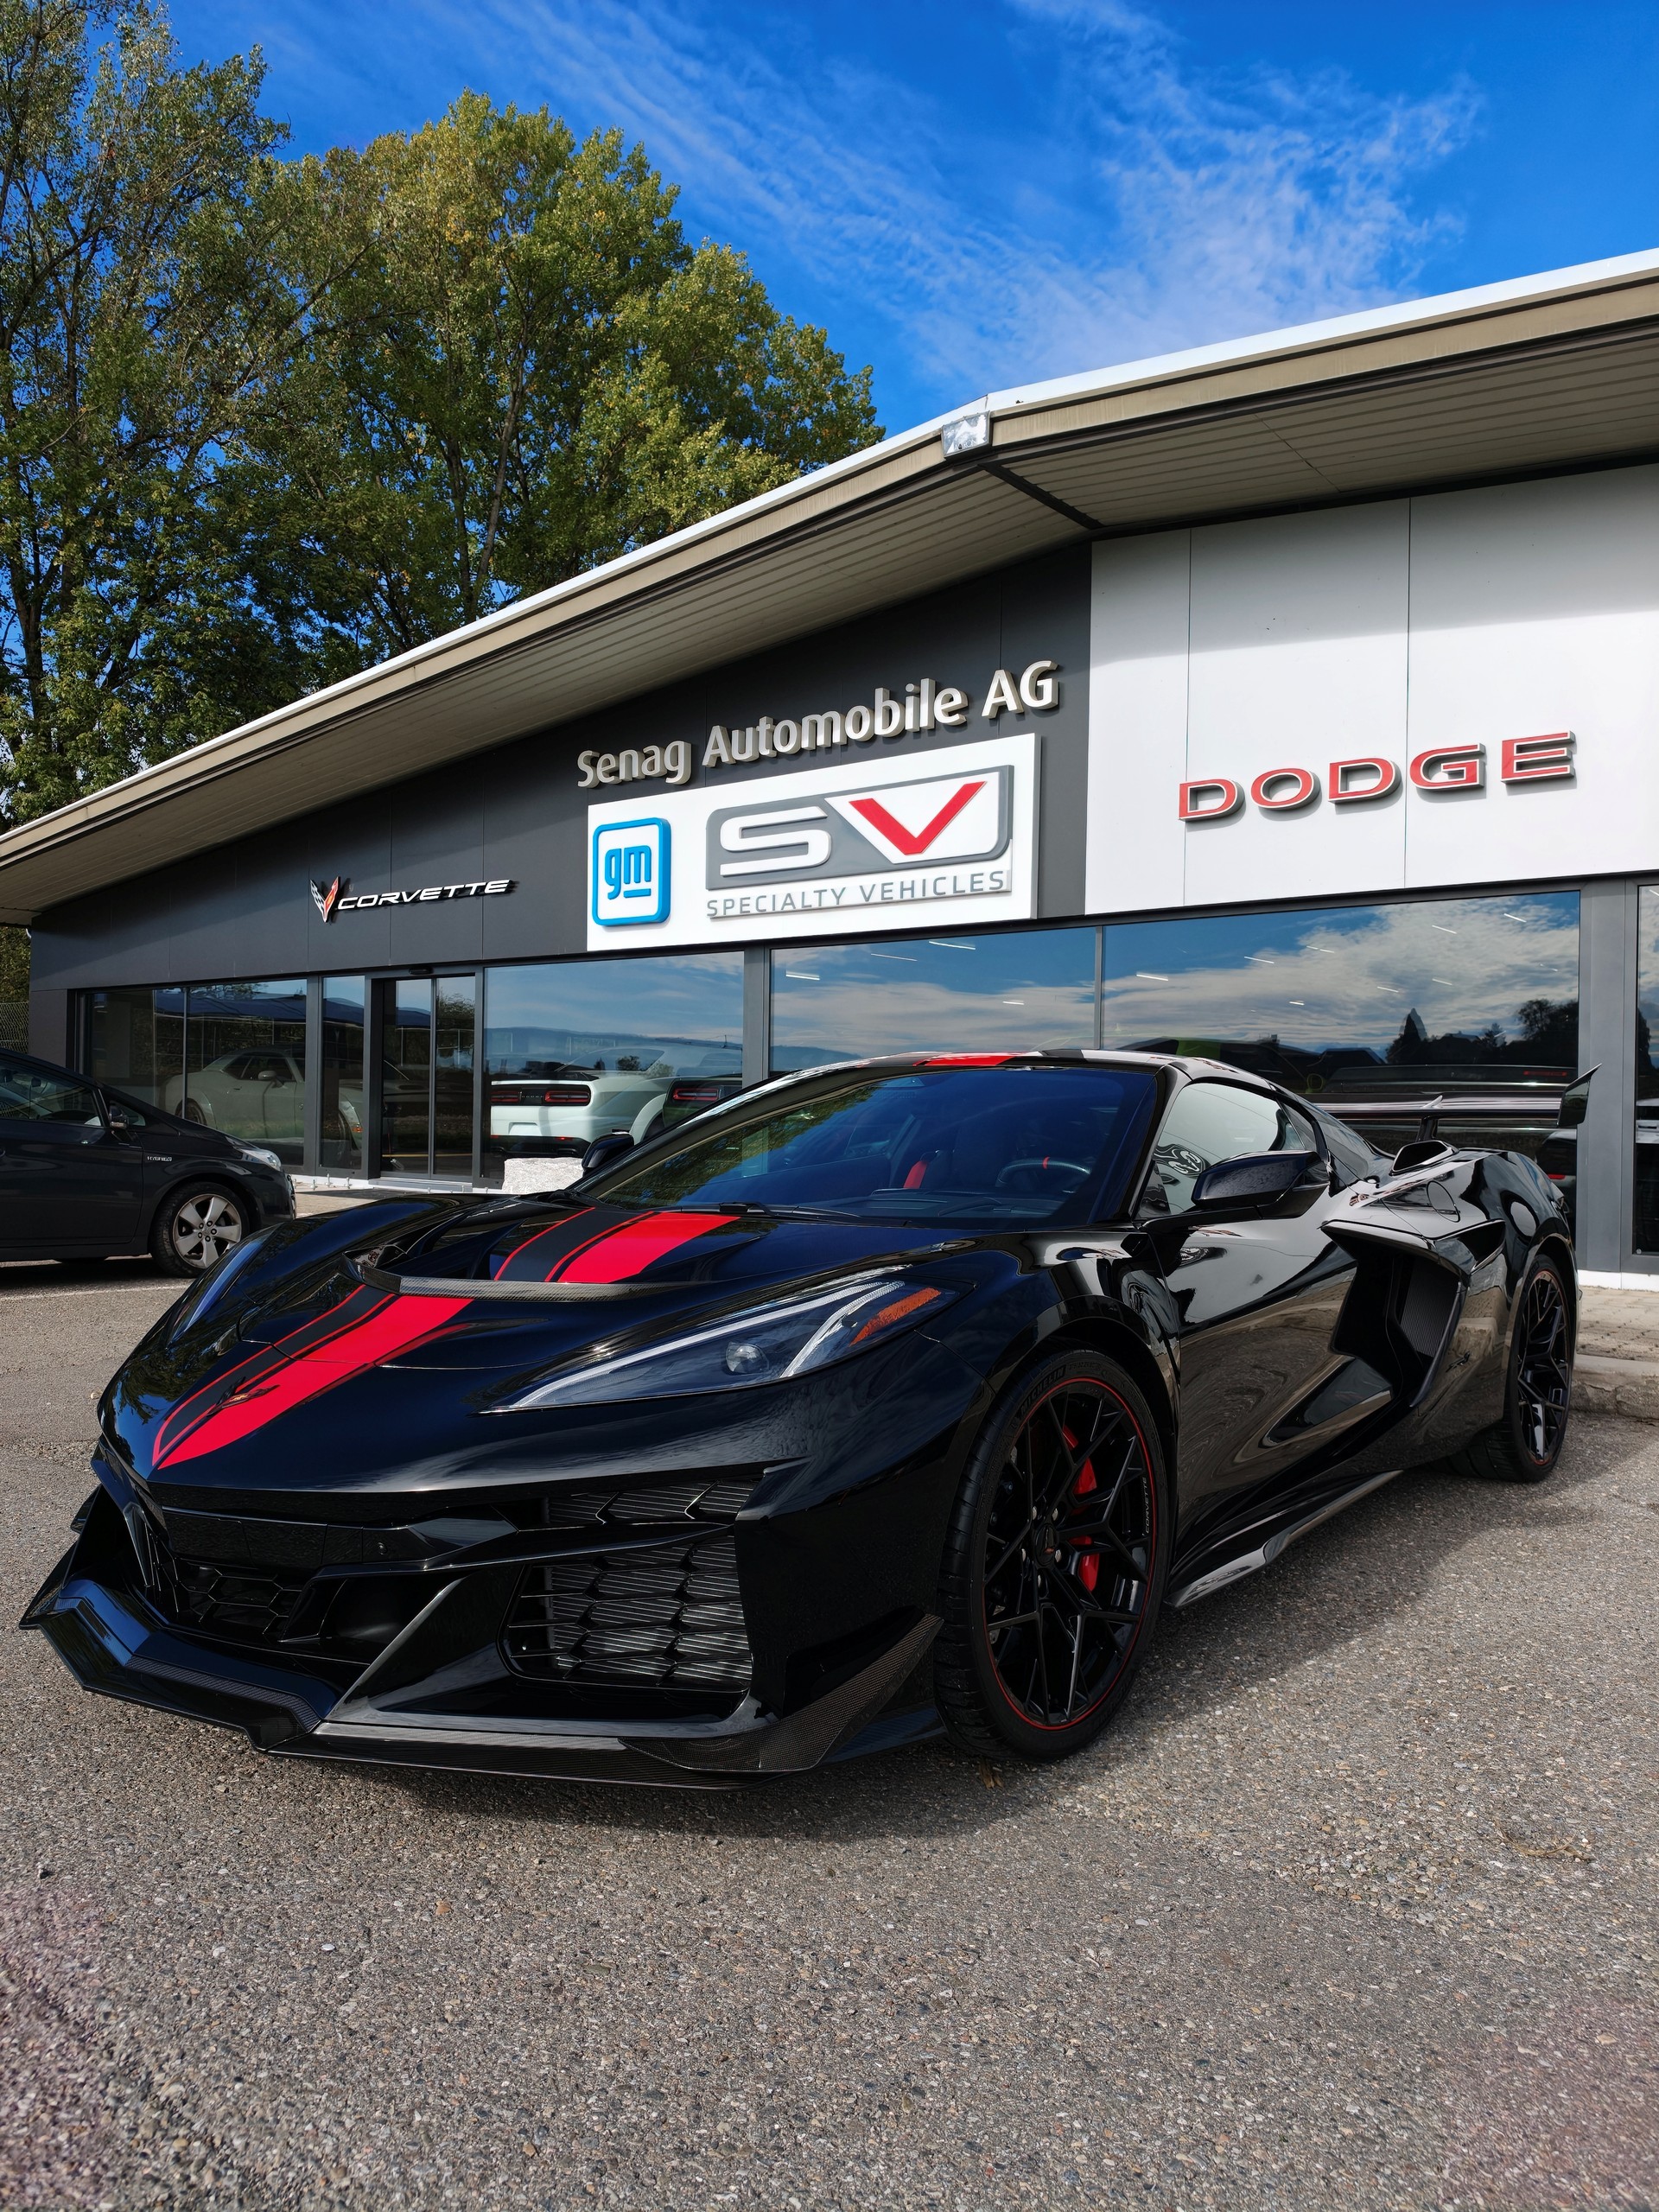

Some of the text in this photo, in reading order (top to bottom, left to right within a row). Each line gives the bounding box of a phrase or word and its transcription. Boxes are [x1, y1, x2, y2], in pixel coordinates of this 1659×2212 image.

[577, 659, 1059, 788] Senag Automobile AG
[1178, 729, 1576, 823] DODGE
[719, 779, 988, 878] SV
[337, 879, 512, 911] CORVETTE
[604, 843, 652, 900] gm
[706, 869, 1006, 918] SPECIALTY VEHICLES
[1015, 1364, 1067, 1418] MICHELIN
[1141, 1476, 1151, 1535] CORVETTE
